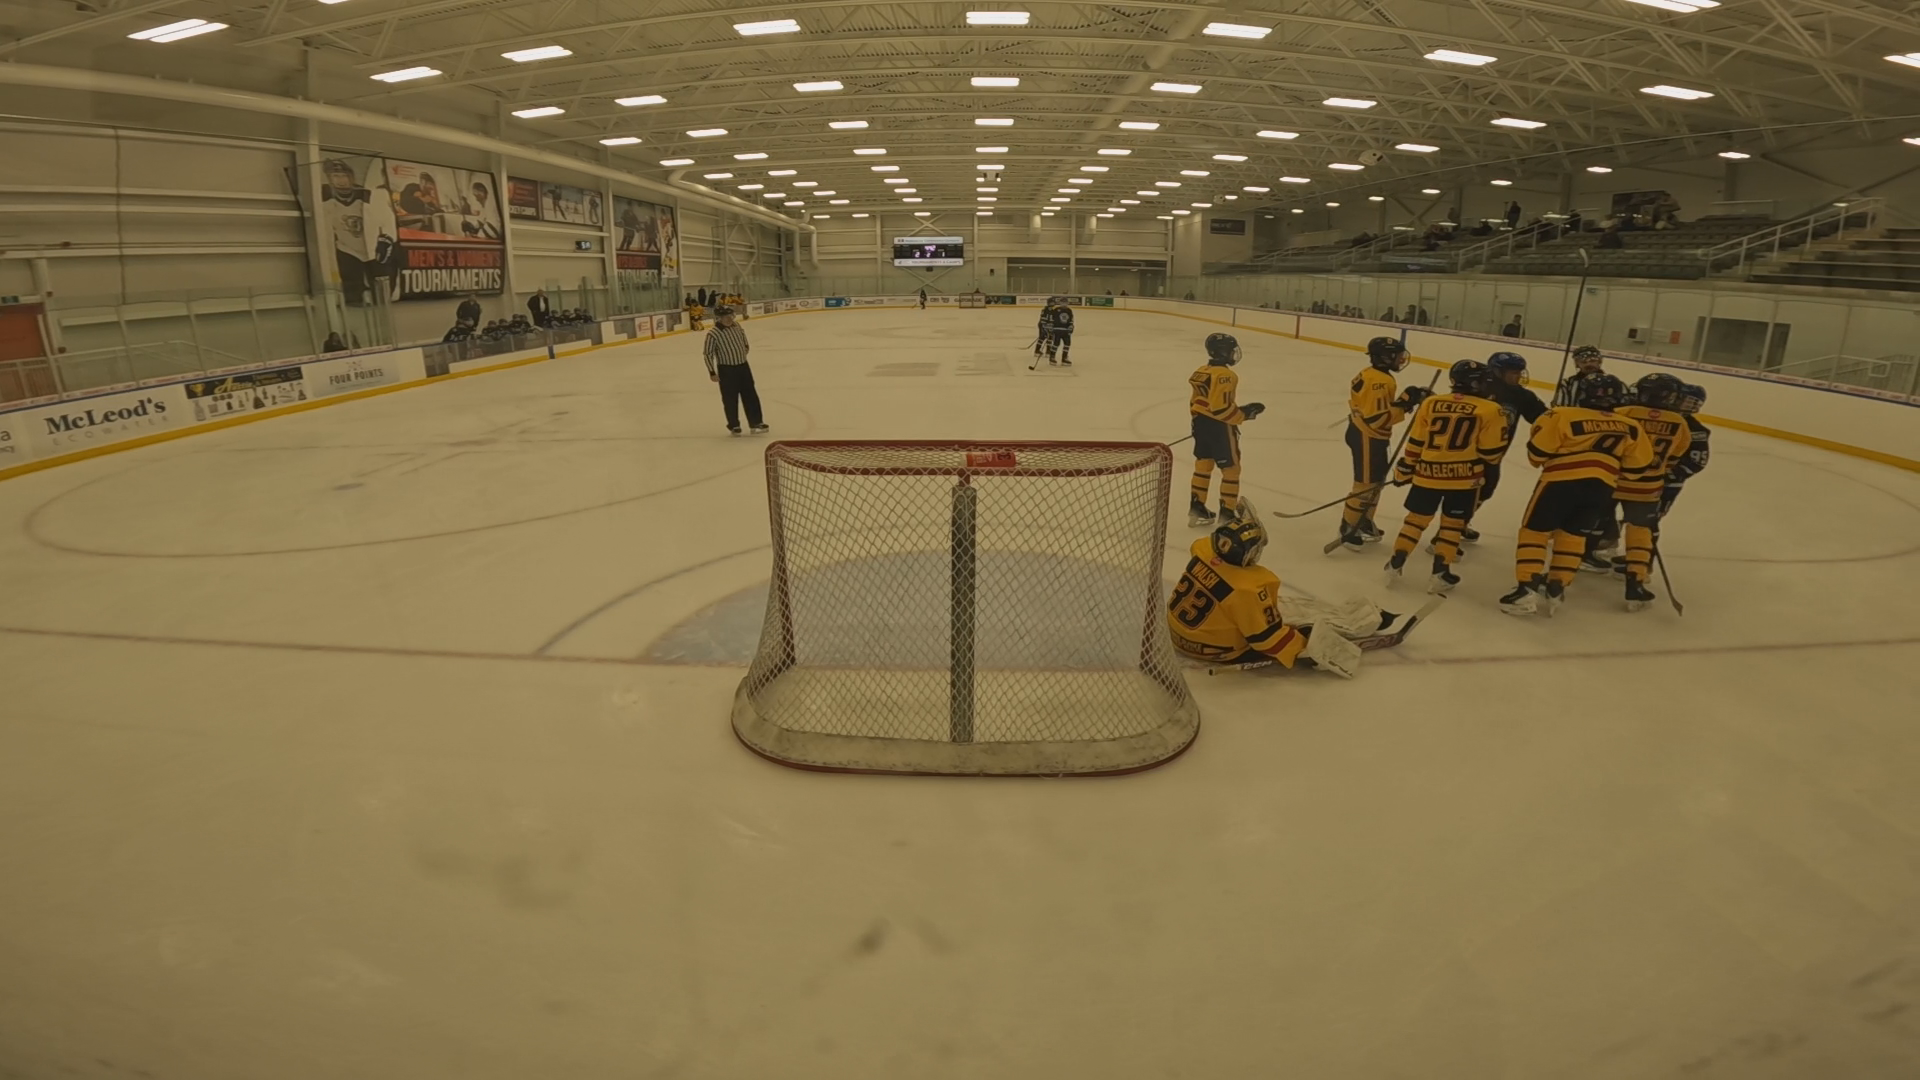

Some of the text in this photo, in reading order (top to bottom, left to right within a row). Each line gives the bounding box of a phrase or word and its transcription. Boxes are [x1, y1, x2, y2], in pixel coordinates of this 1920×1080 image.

[408, 249, 501, 267] MEN'S & WOMEN'S
[401, 268, 501, 294] TOURNAMENTS
[329, 368, 384, 385] FOUR POINTS
[1218, 376, 1232, 385] GK
[1371, 382, 1388, 391] GK
[43, 396, 167, 436] McLeod's
[1434, 400, 1475, 414] KEYES
[1427, 416, 1478, 452] 20
[1432, 462, 1473, 478] ELECTRIC
[1190, 560, 1221, 590] WALSH
[1168, 573, 1217, 631] 33
